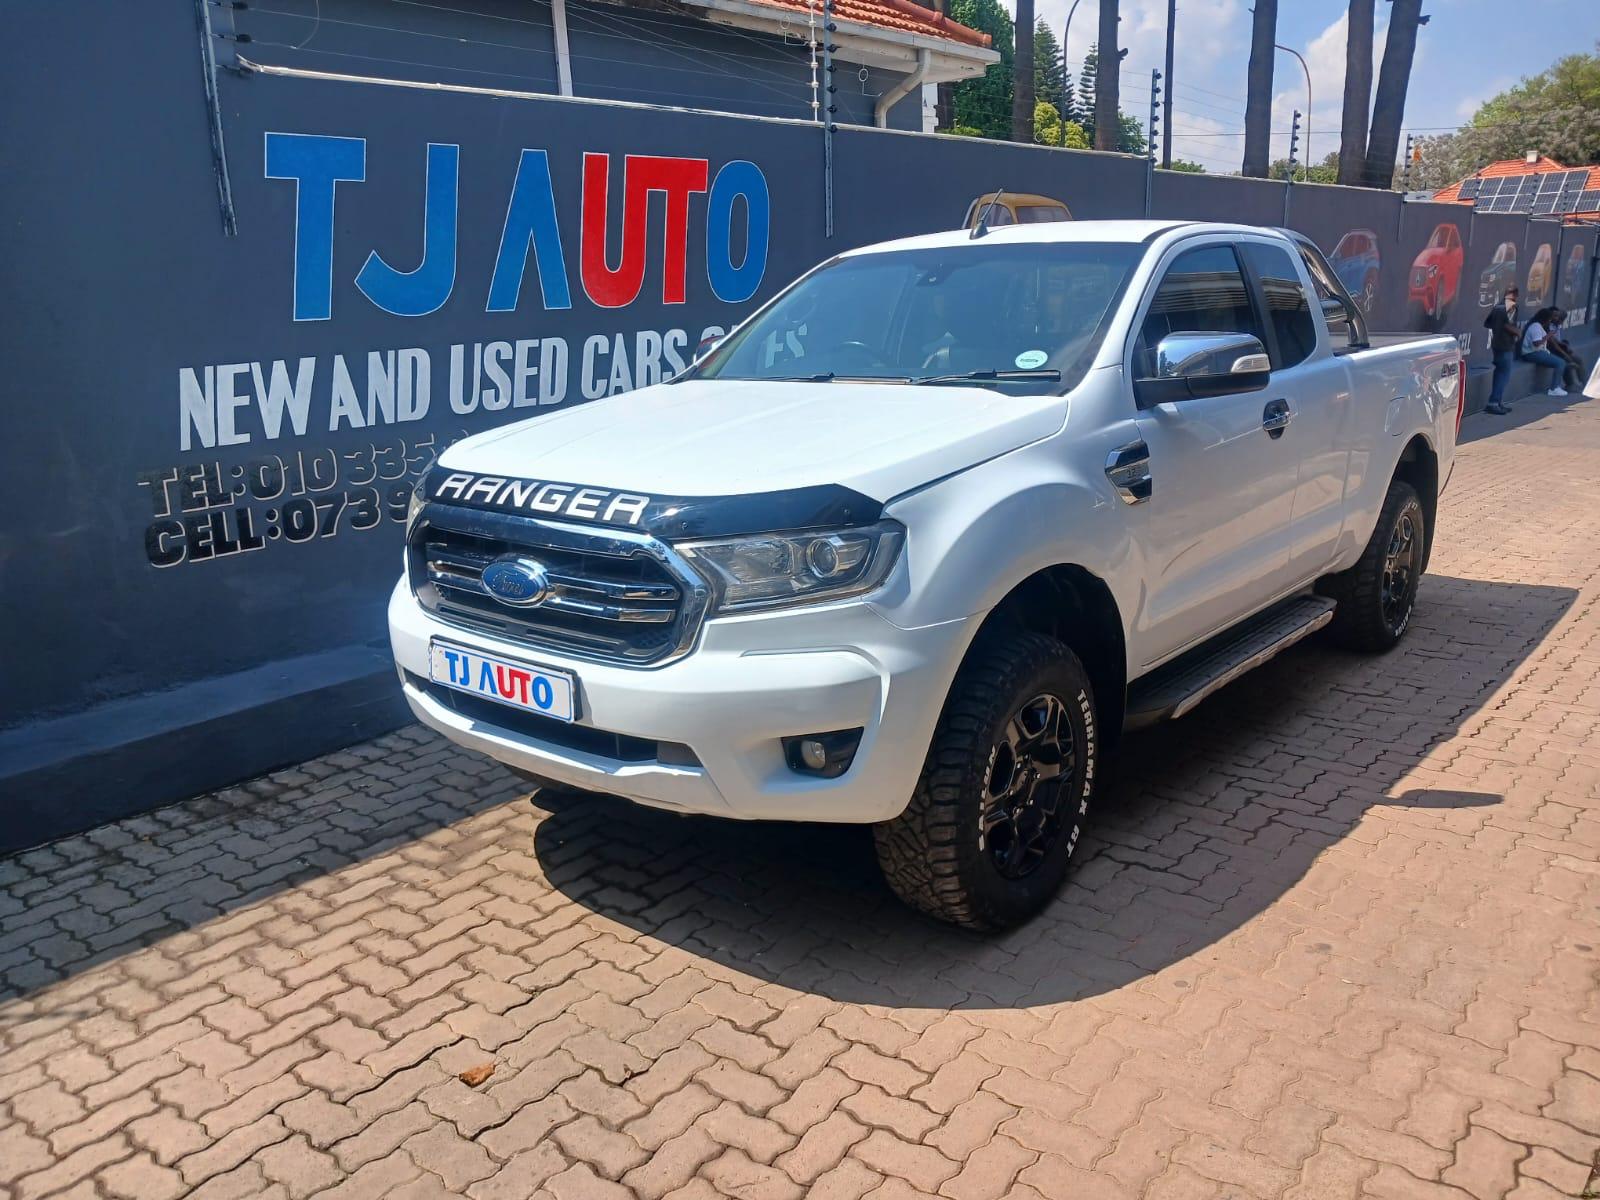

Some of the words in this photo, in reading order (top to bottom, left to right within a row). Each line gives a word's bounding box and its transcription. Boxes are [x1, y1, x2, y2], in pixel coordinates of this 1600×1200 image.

[264, 131, 460, 322] TJ
[485, 148, 770, 312] AUTO
[179, 356, 316, 452] NEW
[328, 347, 431, 432] AND
[449, 336, 569, 415] USED
[581, 328, 688, 400] CARS
[435, 472, 650, 525] RANGER
[444, 650, 471, 686] TJ
[479, 661, 554, 710] AUTO
[1077, 688, 1094, 816] TERRAMAX
